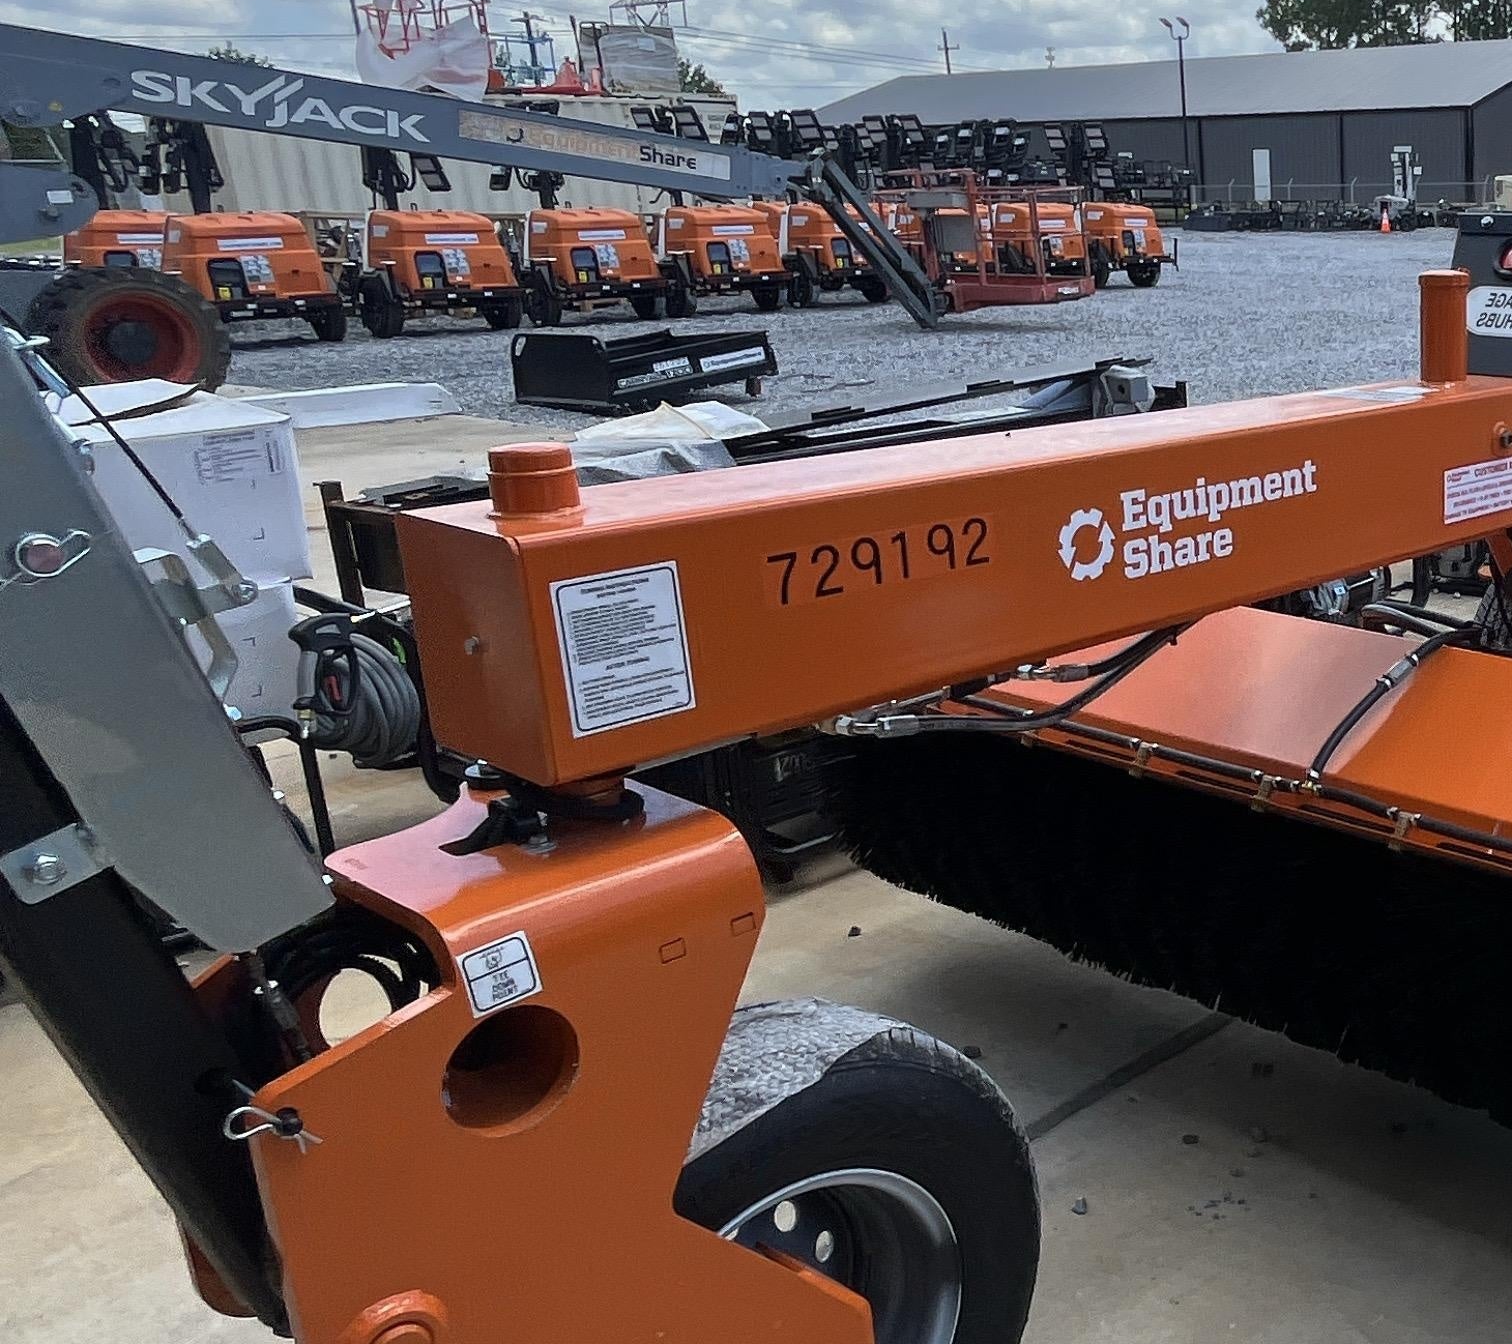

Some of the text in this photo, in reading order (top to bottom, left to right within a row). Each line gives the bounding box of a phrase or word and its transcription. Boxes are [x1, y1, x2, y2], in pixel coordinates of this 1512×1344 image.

[131, 70, 430, 143] SKYJACK
[639, 145, 697, 170] Share
[1120, 459, 1318, 533] Equipment
[767, 517, 990, 605] 729192
[1123, 528, 1233, 579] Share
